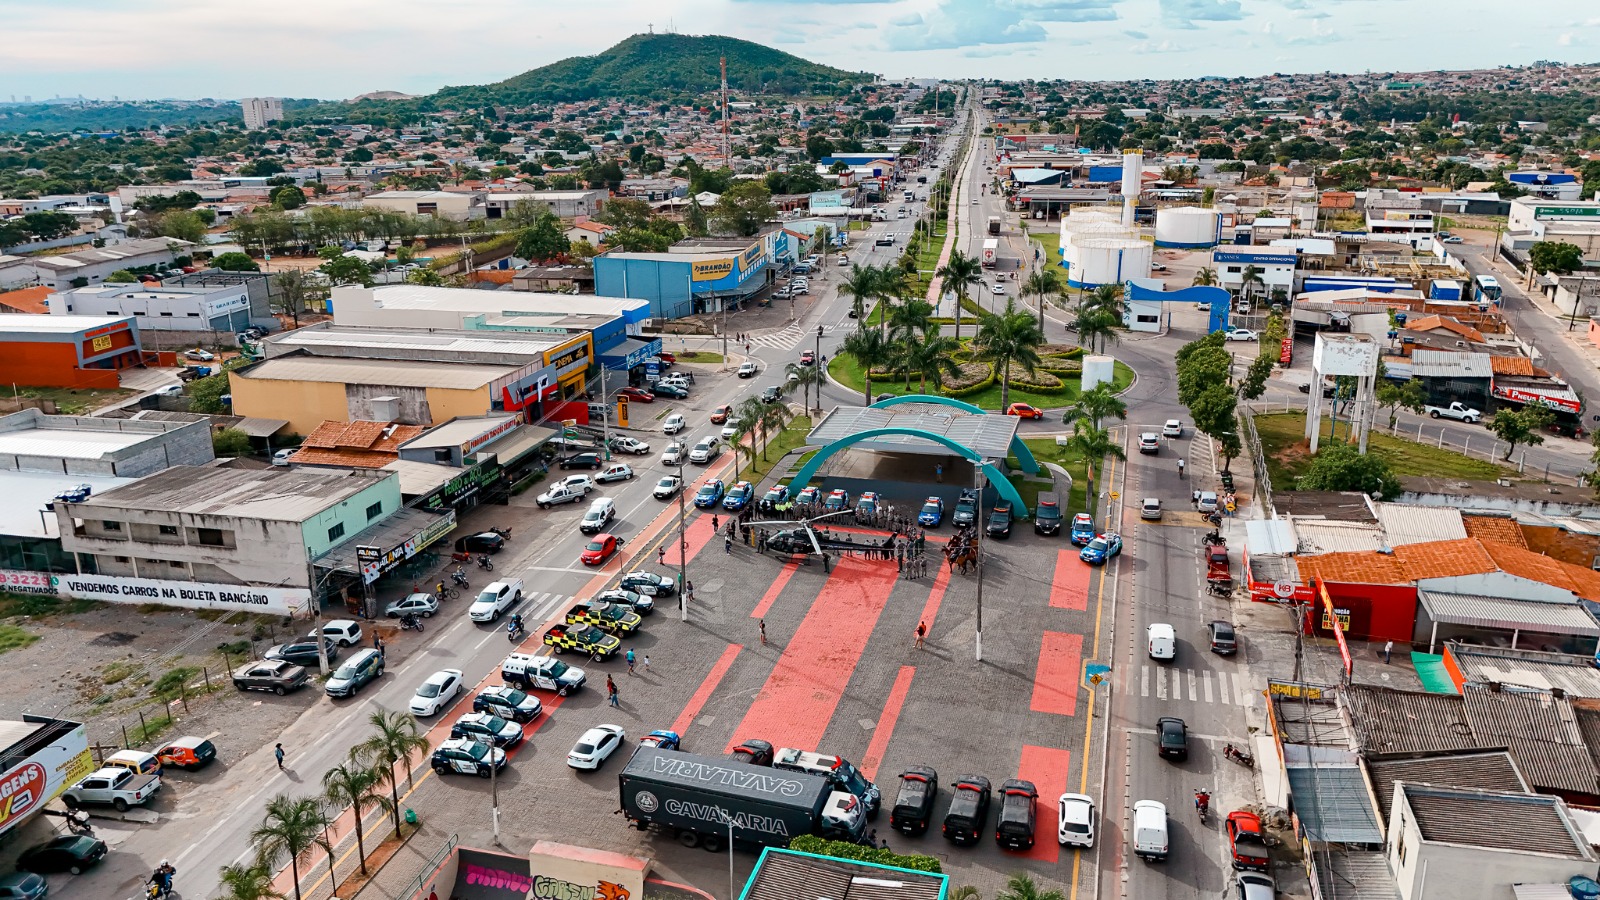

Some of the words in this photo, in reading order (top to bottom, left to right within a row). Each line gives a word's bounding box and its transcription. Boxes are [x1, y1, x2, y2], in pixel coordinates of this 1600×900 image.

[700, 262, 731, 272] BRANDÃO
[8, 585, 59, 595] NEGATIVADOS
[68, 581, 119, 595] VENDEMOS
[122, 585, 159, 598] CARROS
[162, 588, 177, 598] NA
[180, 589, 217, 601] BOLETA
[219, 591, 269, 605] BANCÁRIO
[56, 749, 89, 772] EMBALAGENS
[65, 759, 82, 772] DOCES
[0, 765, 39, 800] GENS
[654, 756, 803, 797] CAVALARIA
[665, 798, 789, 836] CAVALARIA
